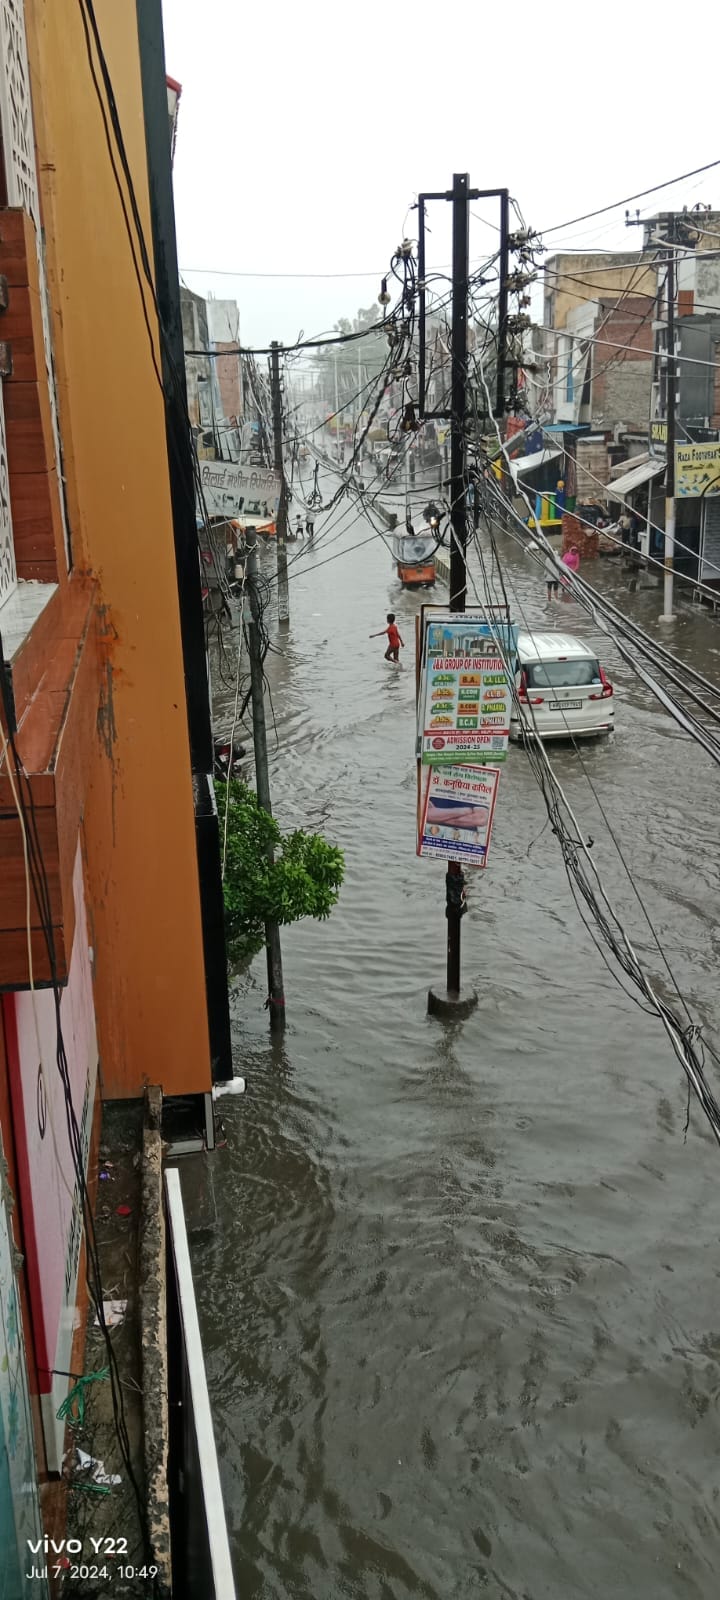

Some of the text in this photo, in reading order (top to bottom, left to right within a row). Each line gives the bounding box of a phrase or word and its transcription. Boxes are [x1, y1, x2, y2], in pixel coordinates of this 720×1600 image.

[677, 451, 690, 462] RAZA
[444, 657, 463, 670] GROUP
[464, 657, 471, 670] OF
[447, 736, 476, 745] ADMISSION
[476, 736, 491, 744] OPEN
